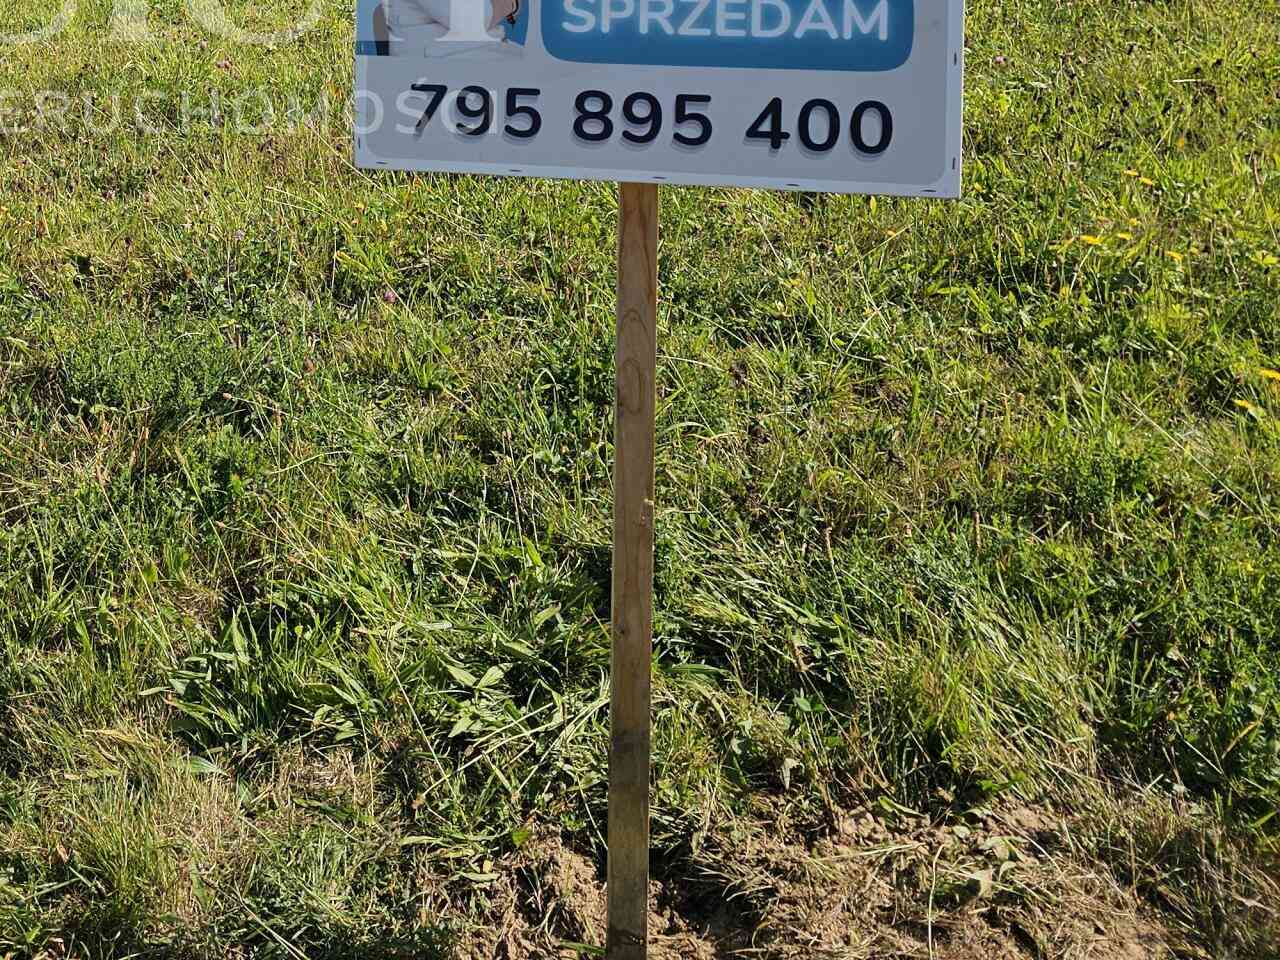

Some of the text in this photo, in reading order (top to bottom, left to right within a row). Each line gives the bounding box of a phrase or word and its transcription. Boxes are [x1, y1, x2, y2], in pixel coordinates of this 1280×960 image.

[410, 83, 893, 155] 795 895 400
